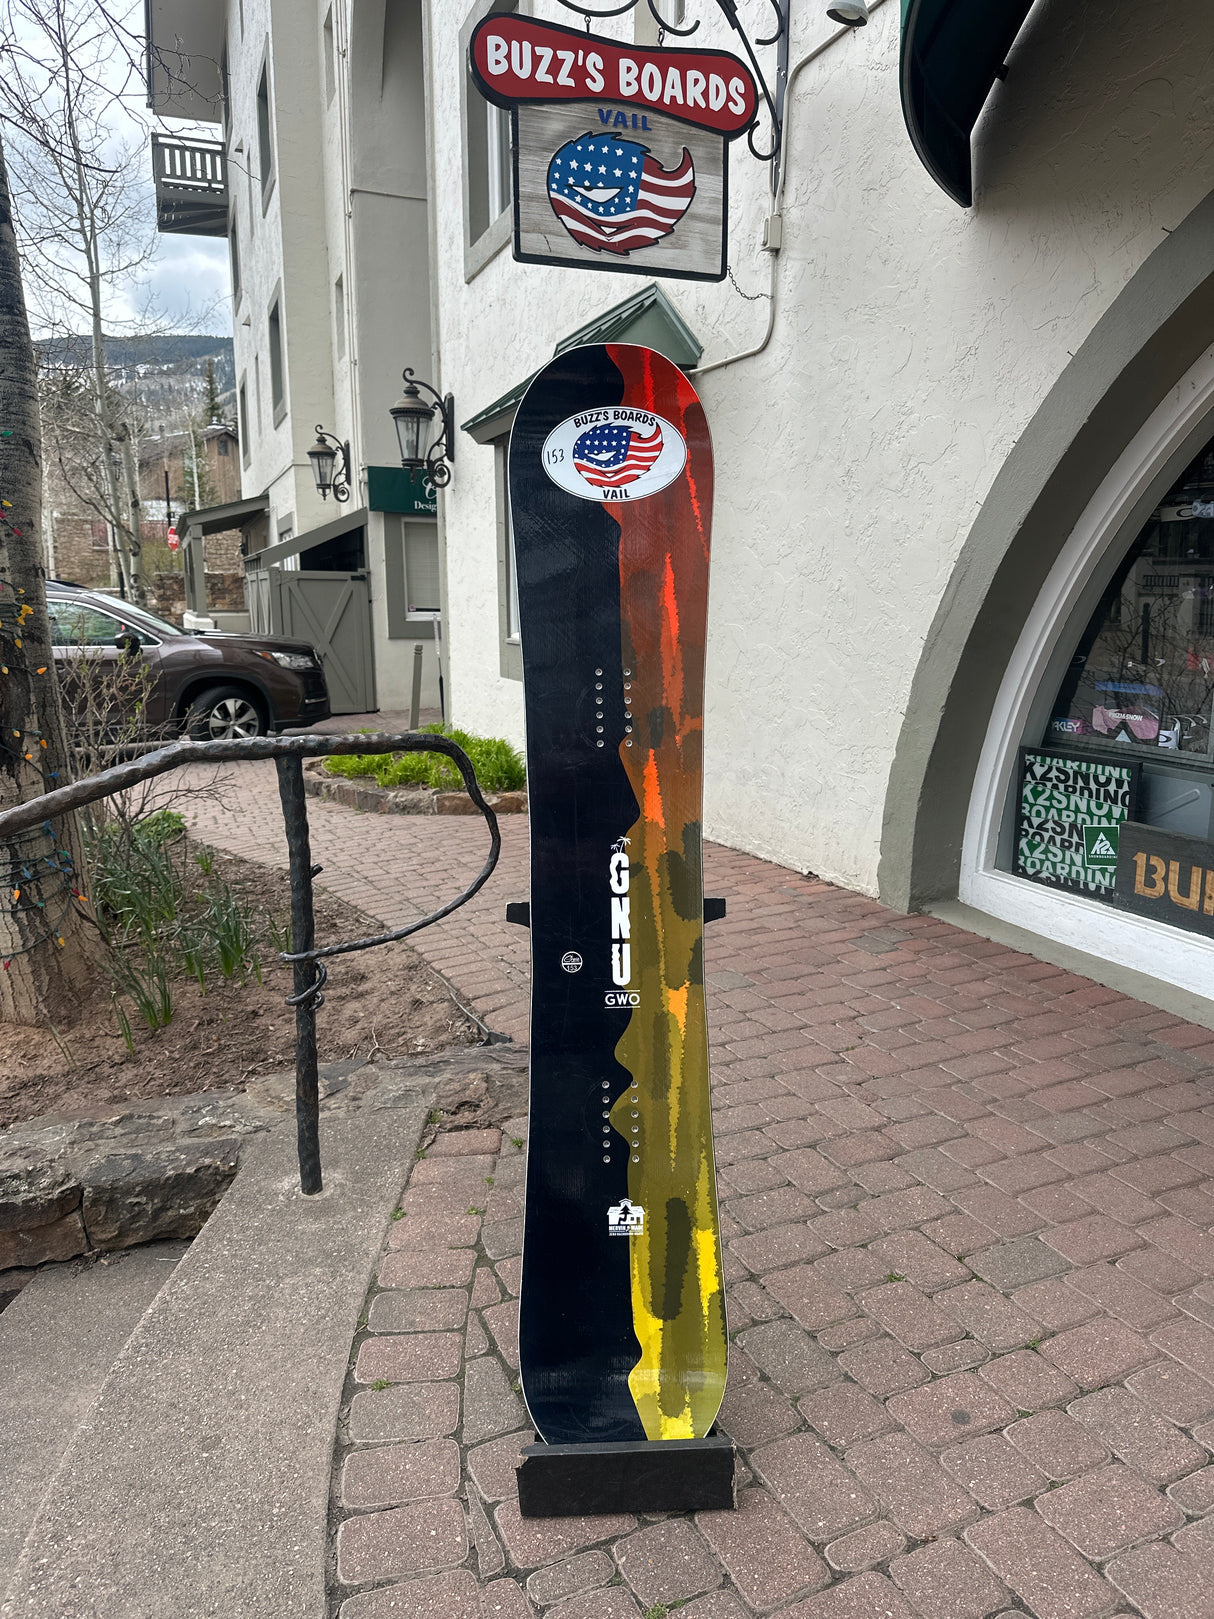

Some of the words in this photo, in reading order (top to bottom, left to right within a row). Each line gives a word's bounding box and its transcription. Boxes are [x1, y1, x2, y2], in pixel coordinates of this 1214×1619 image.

[487, 35, 605, 92] BUZZ'S
[618, 58, 745, 115] BOARDS
[598, 109, 652, 131] VAIL
[574, 411, 609, 428] BUZZ'S
[613, 410, 656, 427] BOARDS
[547, 449, 565, 465] 153
[603, 489, 630, 499] VAIL
[414, 501, 437, 513] Desig
[609, 852, 631, 986] GNU
[605, 993, 641, 1006] GWO
